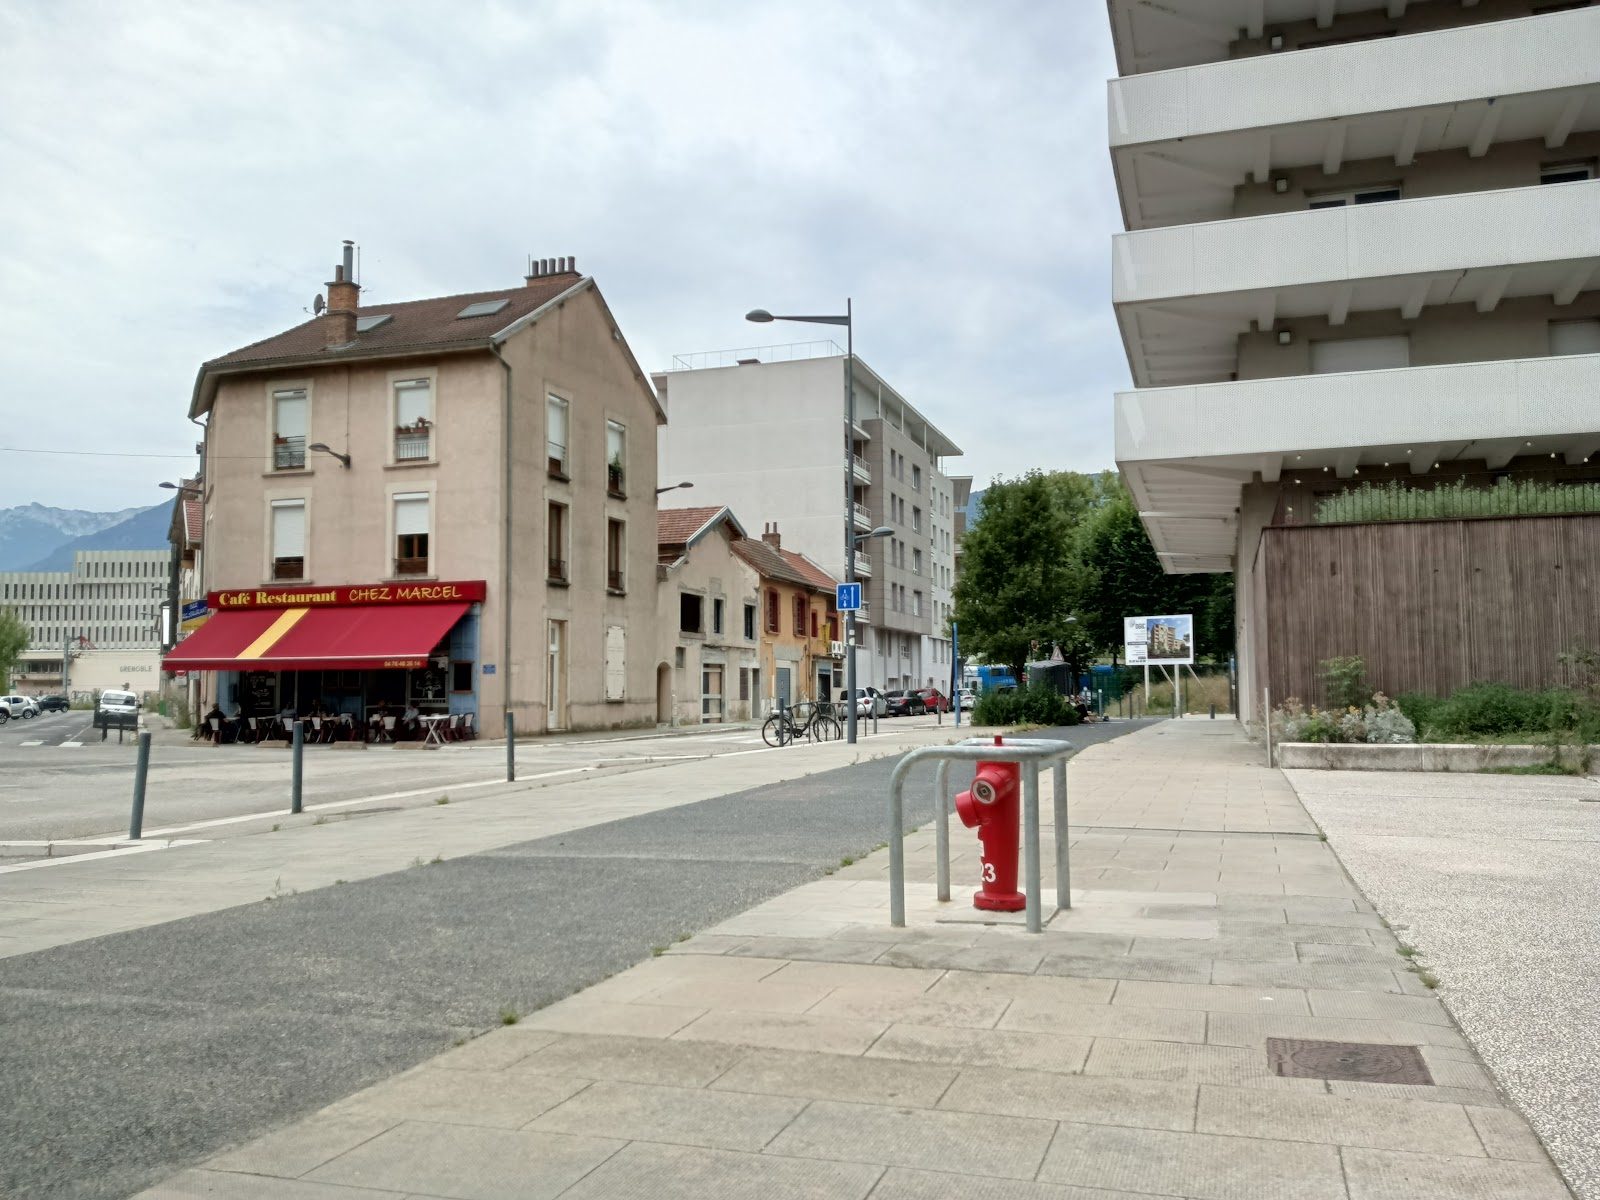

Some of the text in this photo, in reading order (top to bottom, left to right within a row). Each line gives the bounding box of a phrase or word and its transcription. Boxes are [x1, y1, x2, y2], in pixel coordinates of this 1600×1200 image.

[219, 585, 462, 605] Café Restaurant CHEZ MARCEL
[119, 664, 153, 673] GRENOBLE
